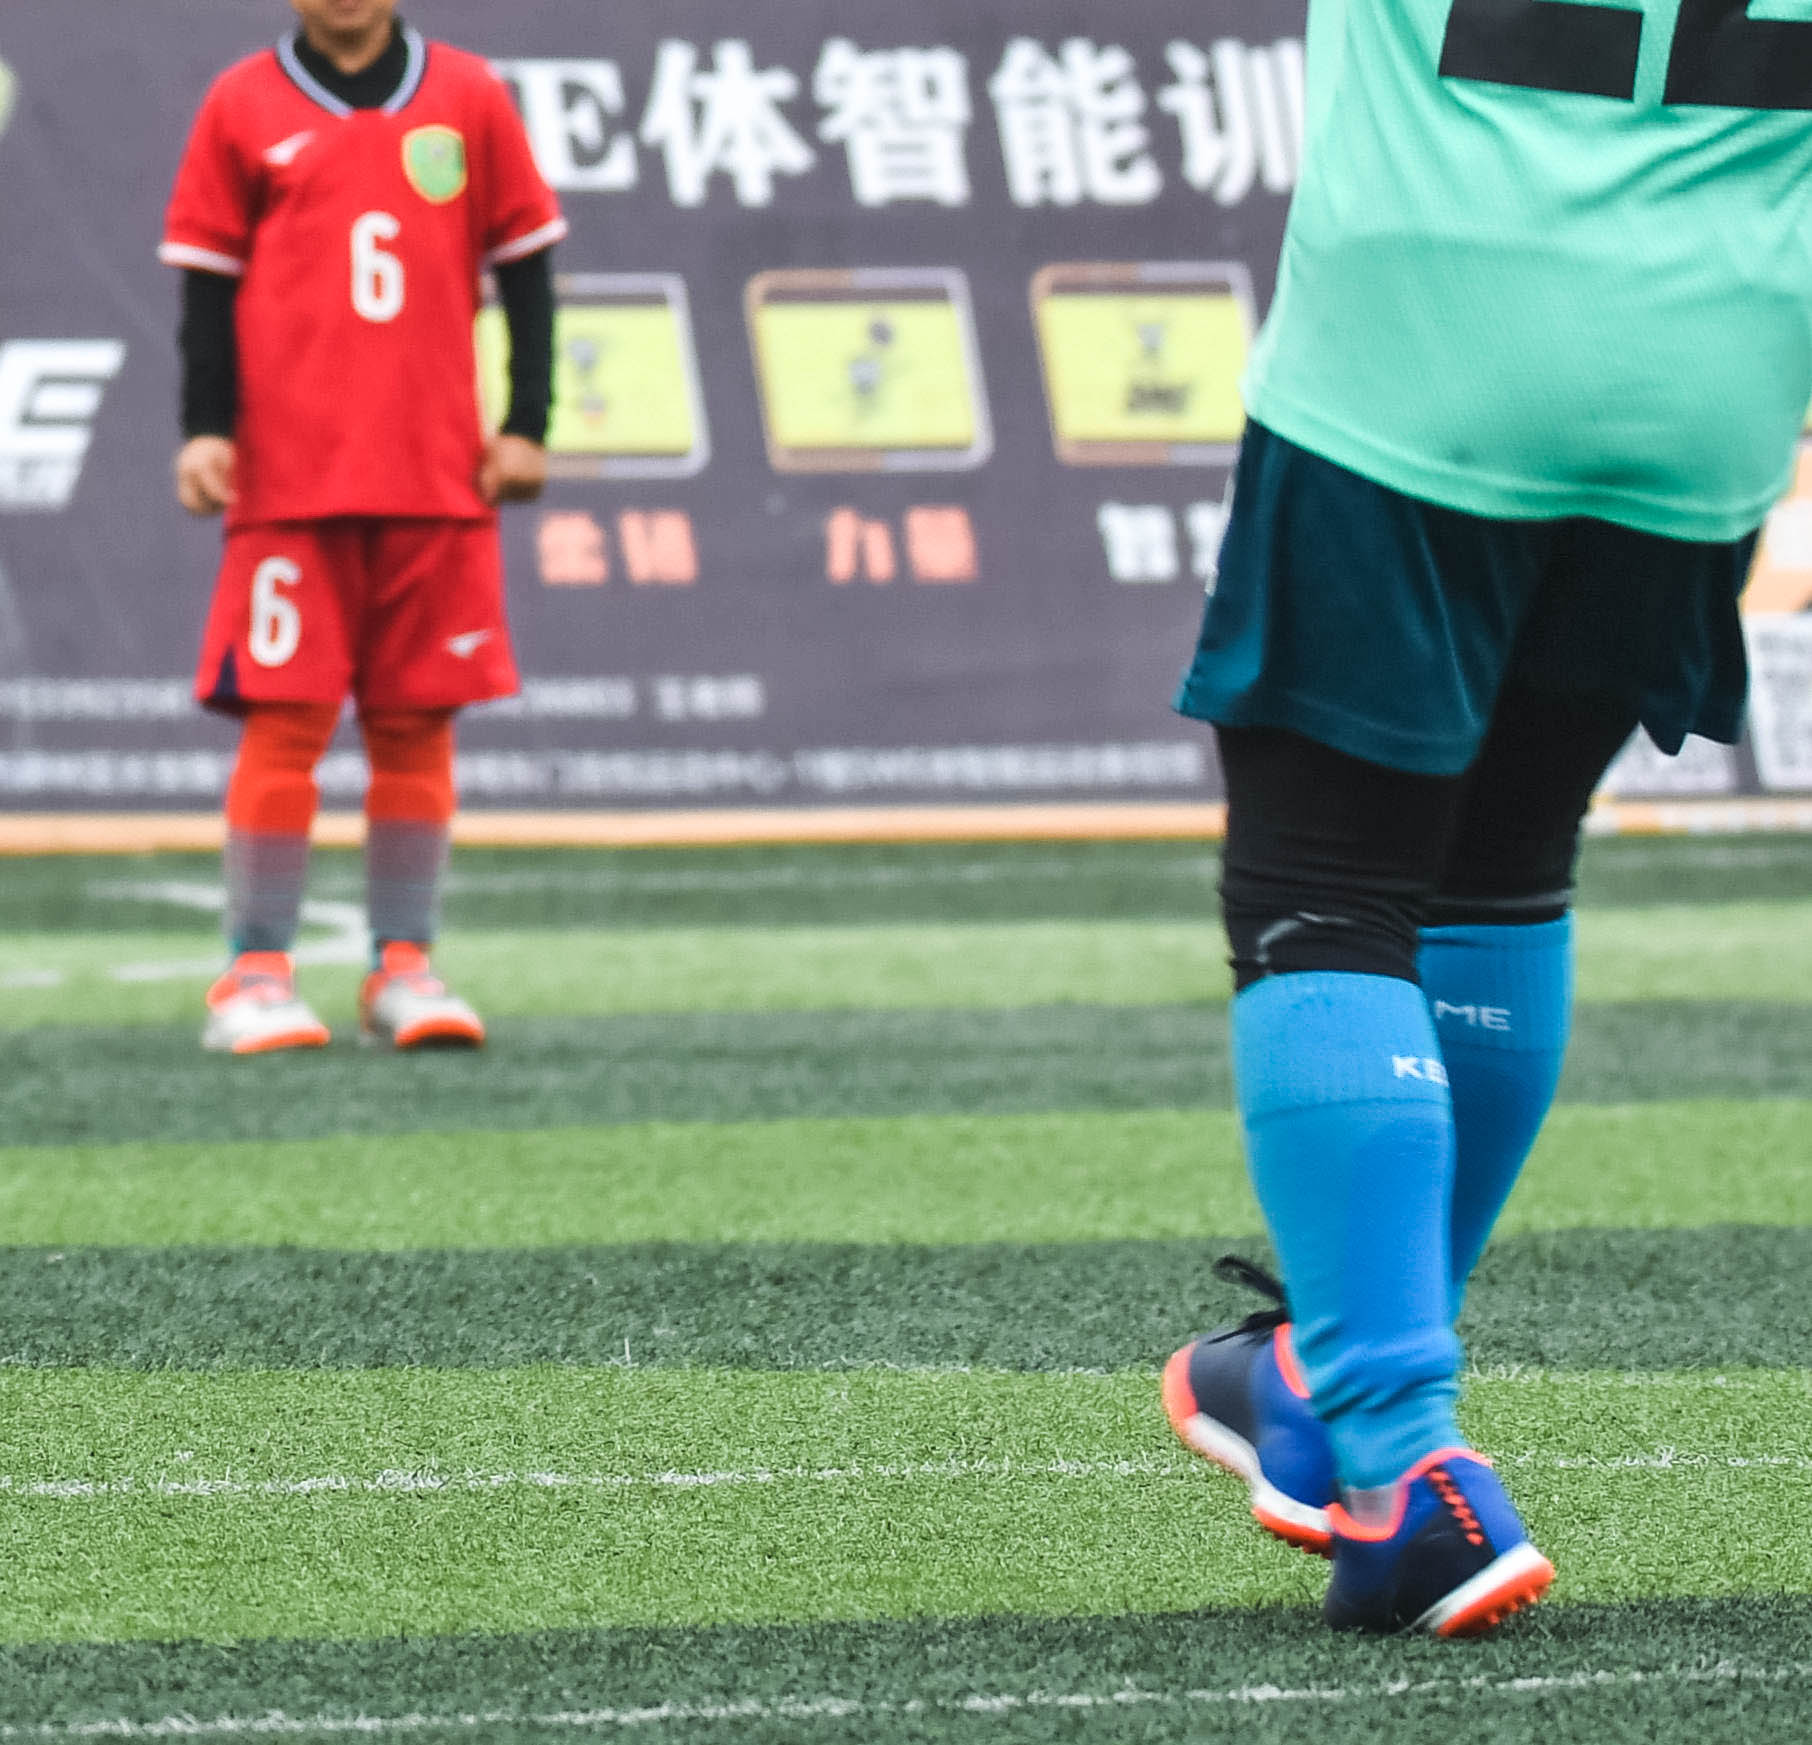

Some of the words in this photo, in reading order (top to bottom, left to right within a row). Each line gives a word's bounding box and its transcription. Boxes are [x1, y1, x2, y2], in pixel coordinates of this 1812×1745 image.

[349, 212, 404, 322] 6
[249, 556, 302, 668] 6
[1434, 999, 1512, 1031] ME
[1391, 1054, 1450, 1088] KE
